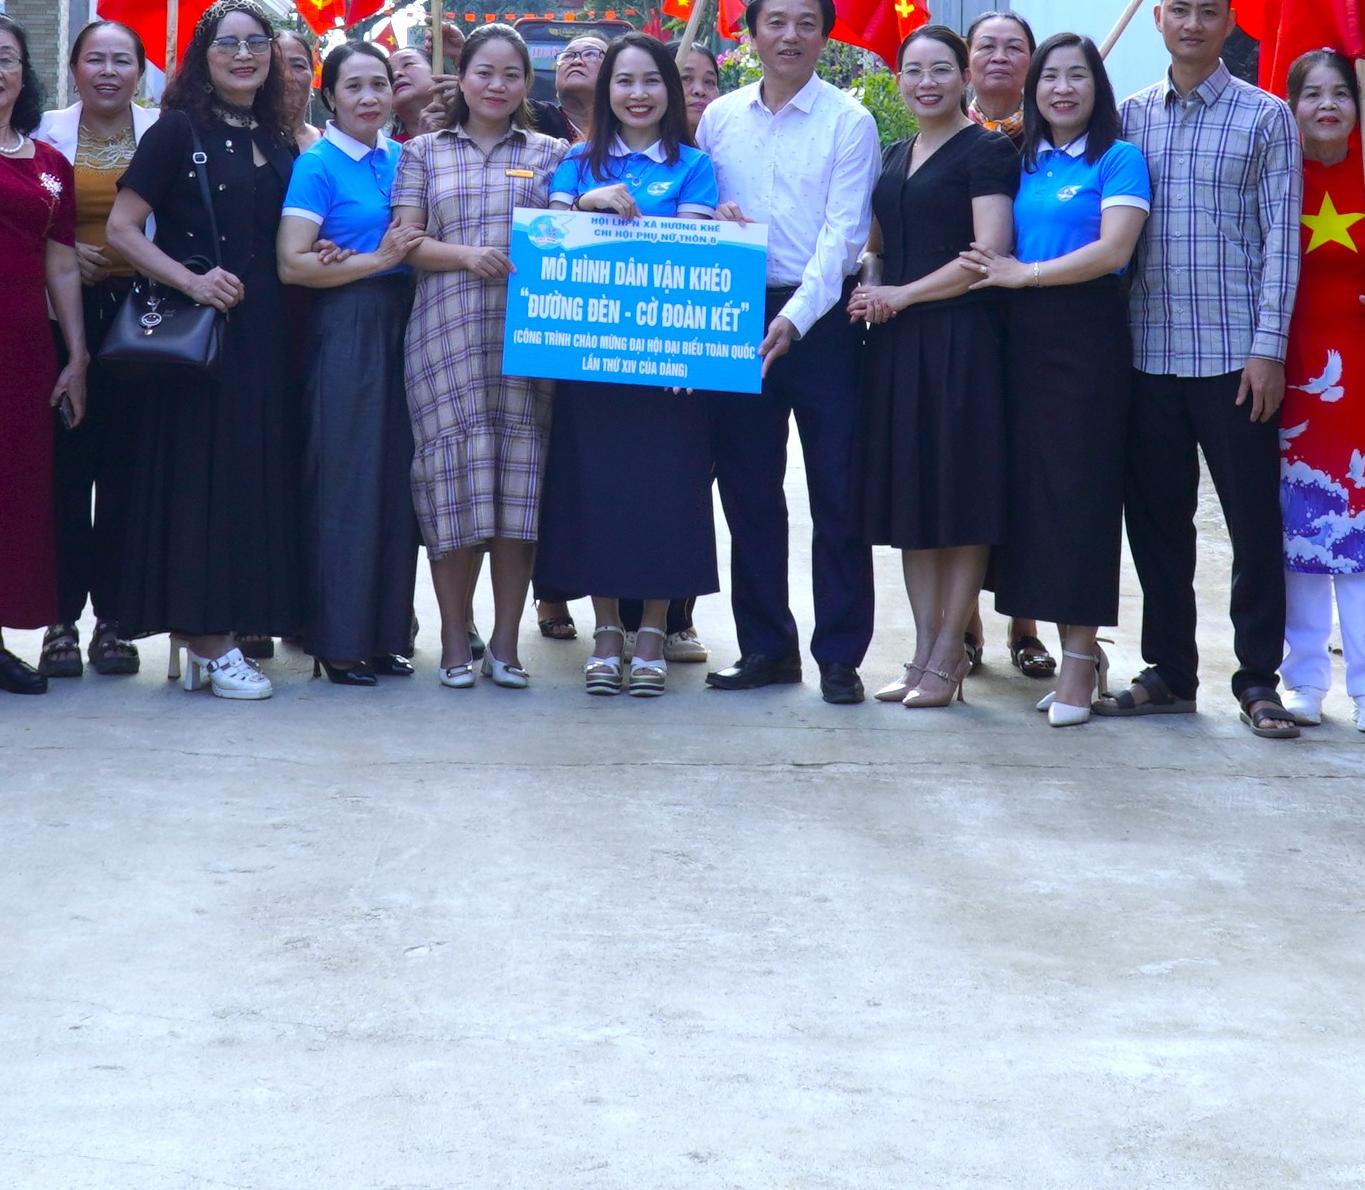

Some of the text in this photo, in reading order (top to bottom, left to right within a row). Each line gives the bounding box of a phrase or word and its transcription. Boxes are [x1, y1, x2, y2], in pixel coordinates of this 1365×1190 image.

[591, 216, 609, 226] HỘI
[612, 218, 640, 228] LHPN
[660, 221, 697, 231] HƯƠNG
[700, 222, 720, 232] KHÊ
[594, 228, 612, 237] CHI
[615, 230, 633, 240] HỘI
[636, 231, 658, 242] PHỤ
[660, 232, 678, 242] NỮ
[680, 233, 707, 243] THÔN
[541, 253, 732, 294] MÔ HÌNH DÂN VẬN KHÉO
[520, 287, 583, 322] “ĐƯỜNG
[588, 294, 620, 324] ĐÈN
[636, 299, 659, 327] CỜ
[662, 301, 708, 330] ĐOÀN
[710, 302, 750, 332] KẾT”
[513, 330, 756, 360] (CÔNG TRÌNH CHÀO MỪNG ĐẠI HỘI ĐẠI BIỂU TOÀN QUỐC
[582, 353, 688, 378] LẦN THỨ XIV CỦA ĐẢNG)
